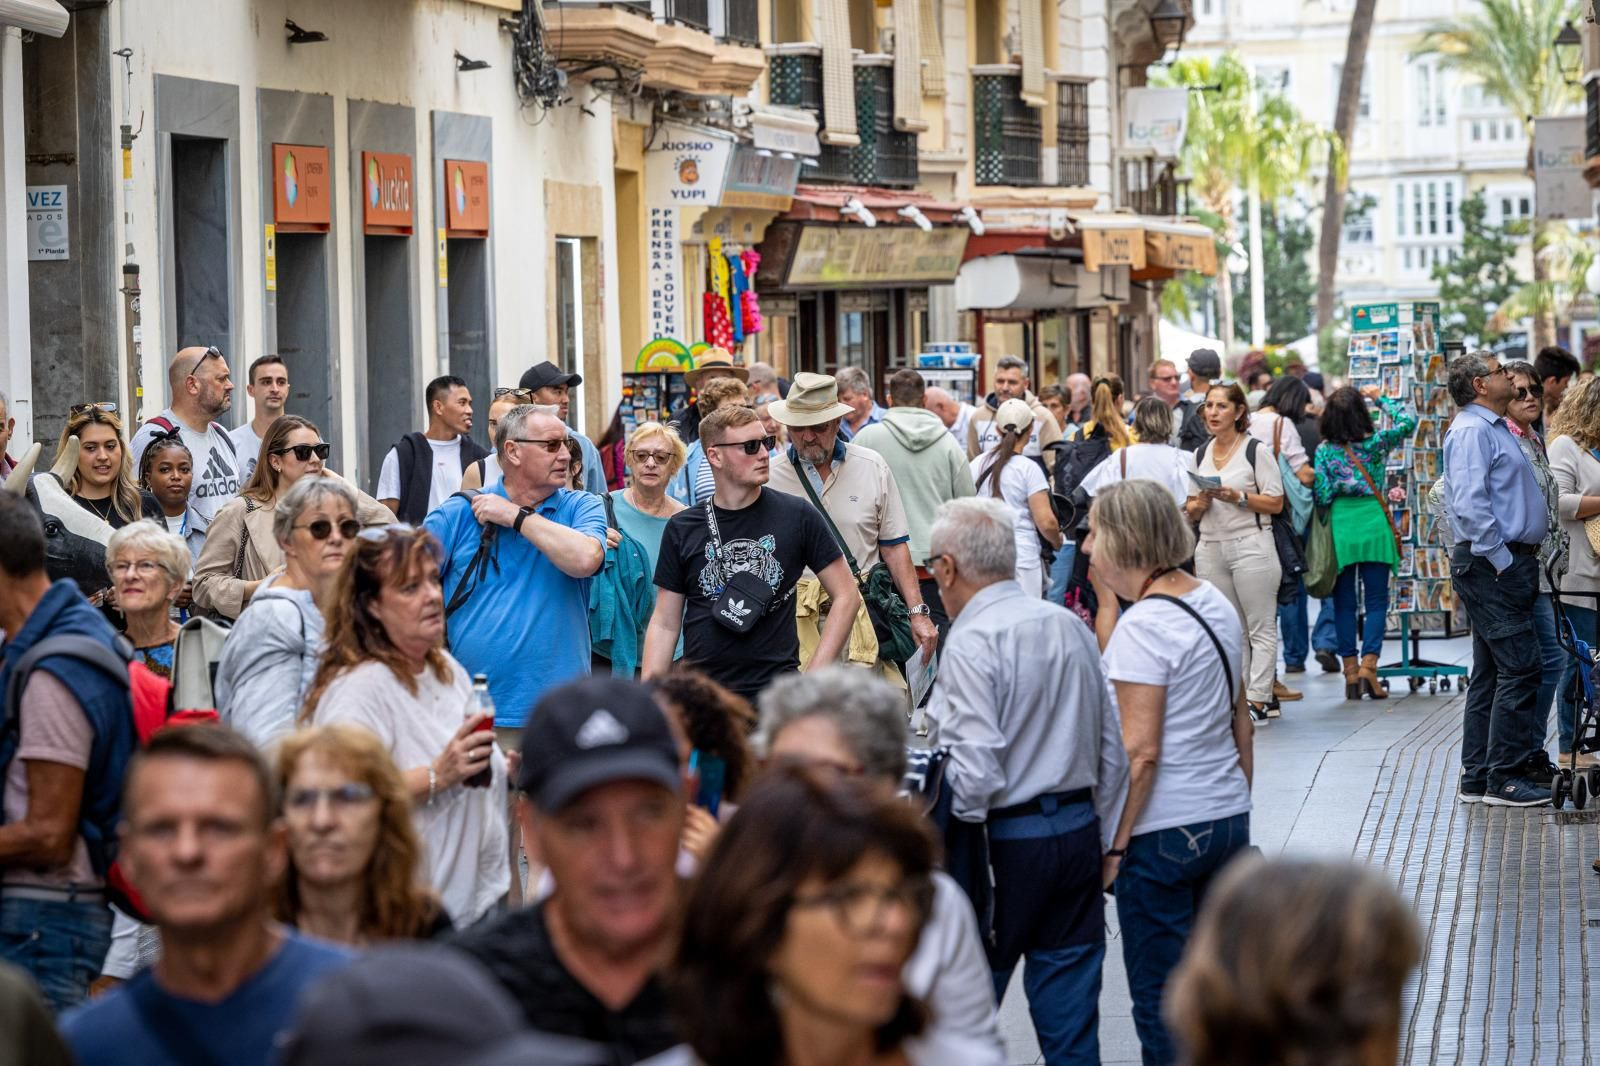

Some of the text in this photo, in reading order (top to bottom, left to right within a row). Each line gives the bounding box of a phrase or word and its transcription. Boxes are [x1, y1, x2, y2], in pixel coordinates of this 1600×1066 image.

[662, 141, 713, 151] KIOSKO
[380, 165, 409, 212] luckia
[671, 189, 706, 199] YUPI
[27, 191, 62, 207] VEZ
[27, 213, 62, 221] ADOS
[652, 208, 661, 270] PRENSA
[45, 247, 65, 255] Planta
[664, 273, 674, 338] SOUVEN
[720, 608, 744, 627] adidas
